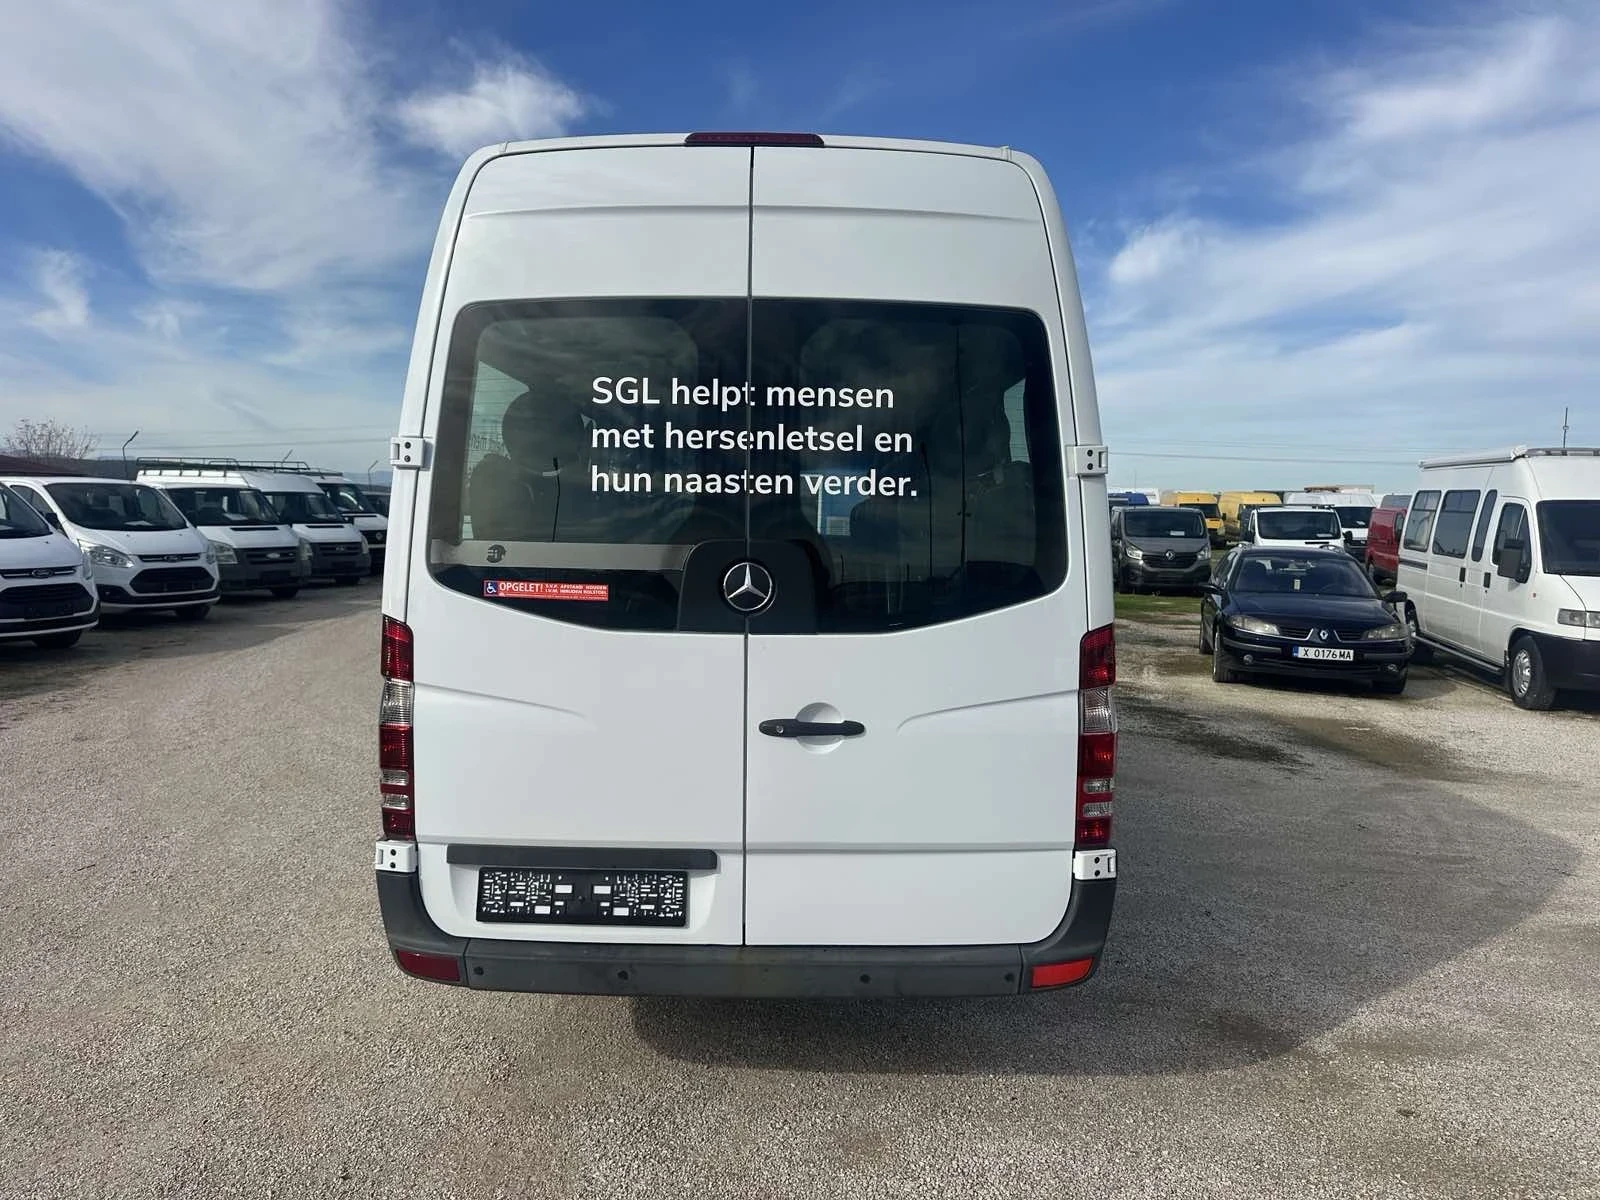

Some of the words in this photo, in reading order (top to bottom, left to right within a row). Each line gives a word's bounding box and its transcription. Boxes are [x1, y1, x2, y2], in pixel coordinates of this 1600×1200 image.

[592, 376, 660, 405] SGL
[671, 377, 755, 411] helpt
[766, 386, 894, 408] mensen
[591, 423, 655, 448] met
[665, 421, 863, 452] hersenletsel
[874, 432, 913, 453] en
[591, 464, 652, 492] hun
[664, 469, 793, 494] naasten
[802, 469, 917, 497] verder.
[499, 582, 543, 592] OPGELET!
[1303, 648, 1309, 657] X
[1314, 649, 1337, 659] 0176
[1339, 651, 1351, 660] MA
